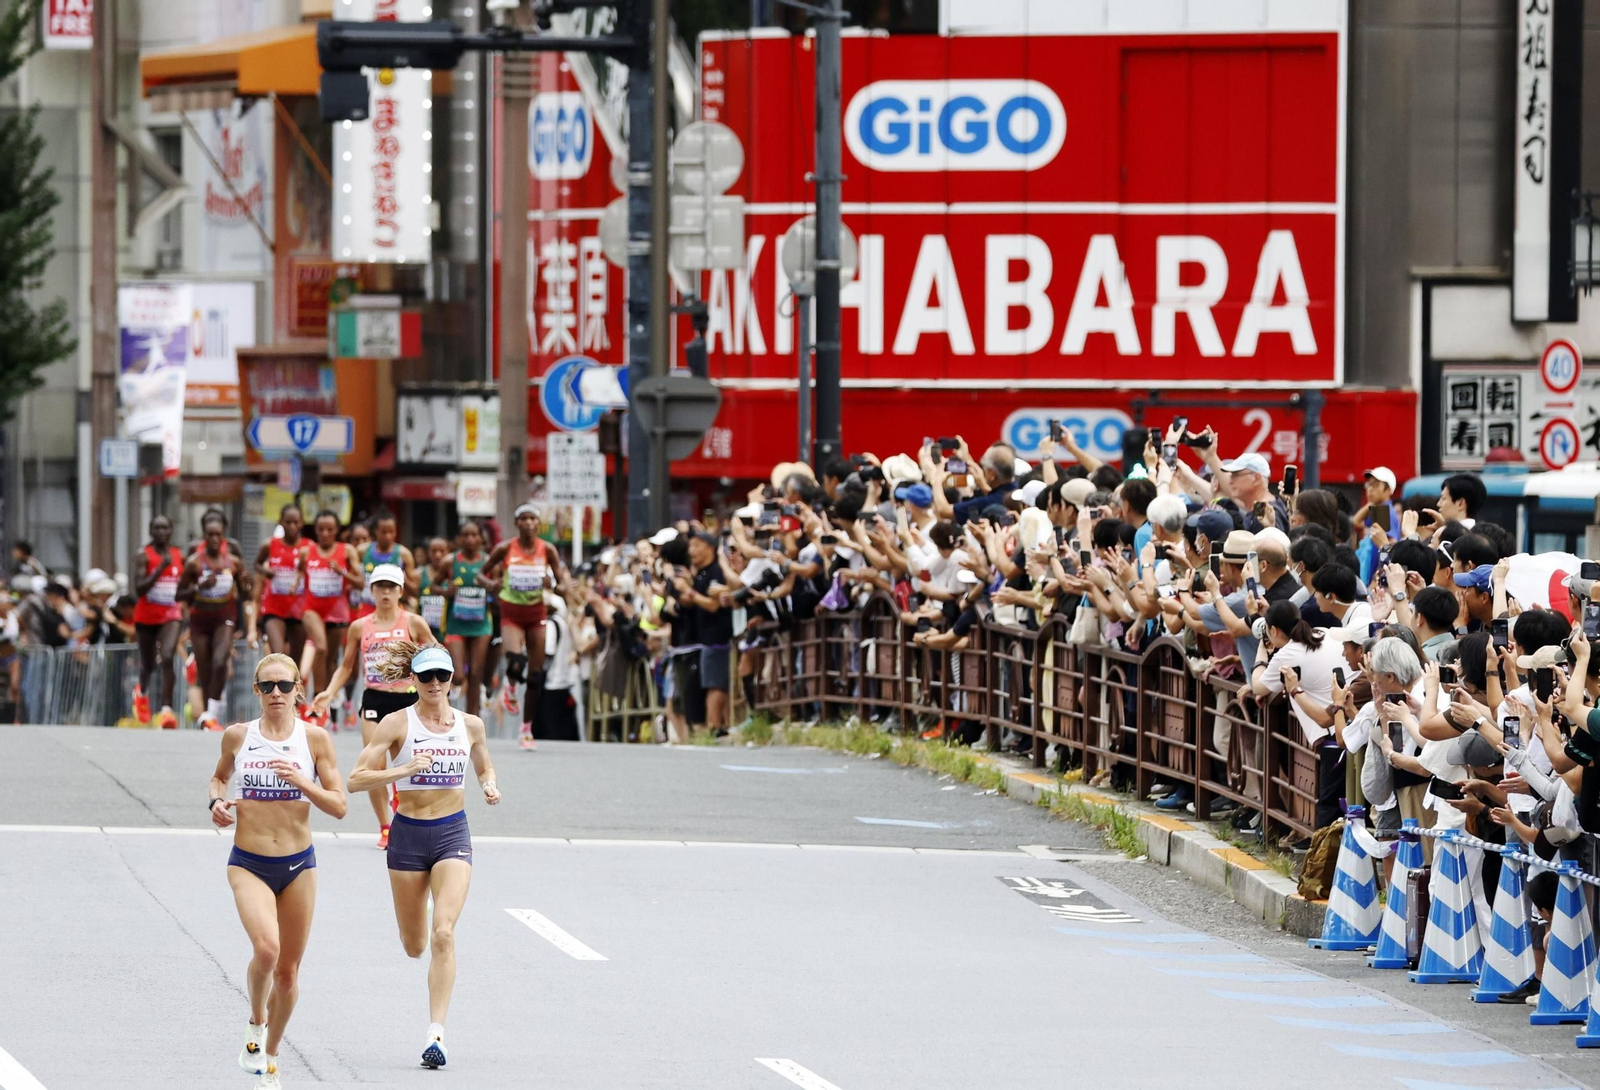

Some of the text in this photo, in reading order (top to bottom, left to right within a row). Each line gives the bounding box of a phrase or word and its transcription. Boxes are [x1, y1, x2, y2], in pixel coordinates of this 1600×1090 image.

[859, 96, 1052, 155] GiGO
[706, 229, 1319, 358] AKIHABARA
[1550, 355, 1572, 379] 40
[1451, 381, 1515, 411] 回転
[294, 419, 315, 443] 17
[1451, 421, 1514, 454] 寿司
[424, 651, 444, 660] USA
[412, 748, 467, 757] HONDA
[243, 774, 295, 788] SULLIVA
